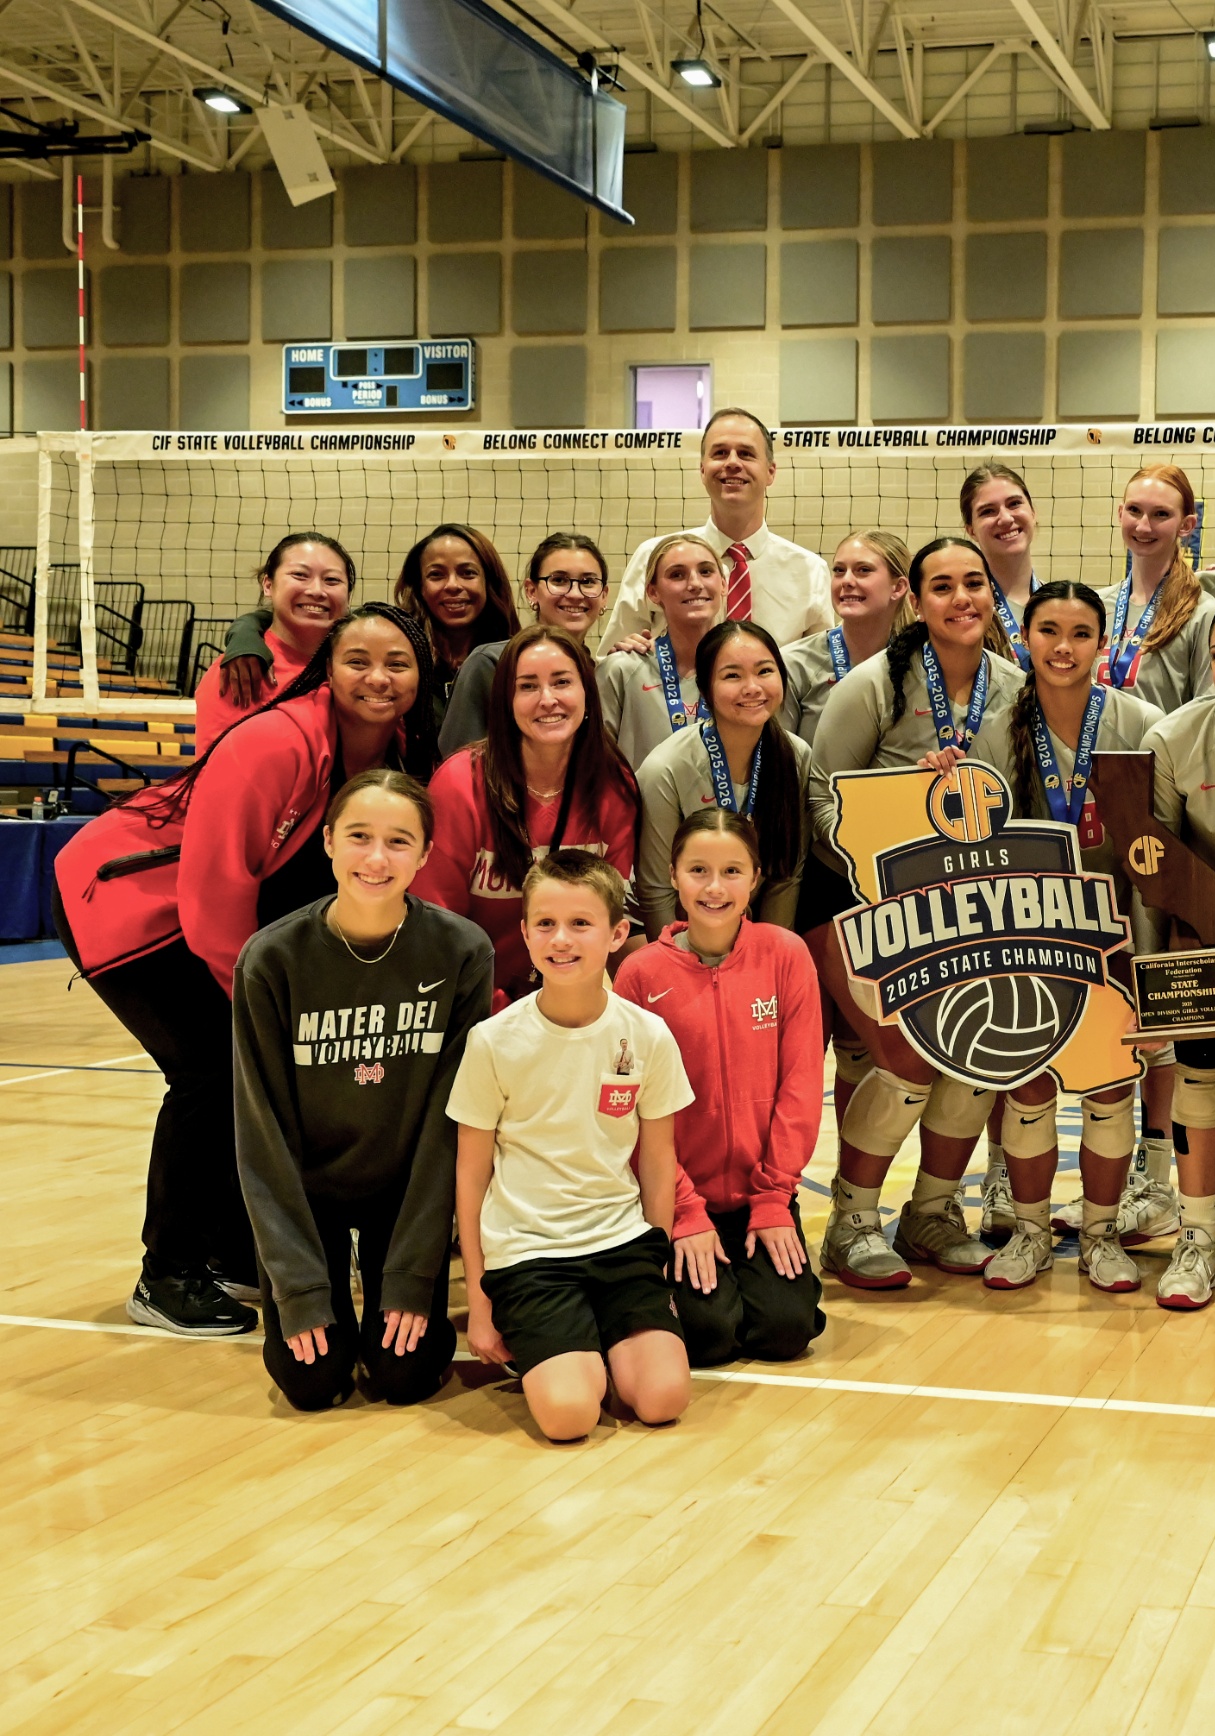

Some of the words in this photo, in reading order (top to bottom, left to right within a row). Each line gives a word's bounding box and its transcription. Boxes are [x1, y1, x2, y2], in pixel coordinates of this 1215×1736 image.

[291, 349, 324, 362] HOME
[423, 345, 468, 359] VISITOR
[304, 398, 331, 407] BONUS
[352, 390, 382, 400] PERIOD
[420, 395, 448, 404] BONUS
[152, 436, 171, 450] CIF
[177, 435, 217, 450] STATE
[224, 435, 304, 450] VOLLEYBALL
[311, 434, 416, 450] CHAMPIONSHIP
[483, 432, 537, 450] BELONG
[543, 431, 608, 449] CONNECT
[614, 431, 682, 448] COMPETE
[783, 431, 830, 447] STATE
[837, 429, 929, 447] VOLLEYBALL
[936, 429, 1057, 446] CHAMPIONSHIP
[1133, 427, 1196, 444] BELONG
[658, 643, 679, 706] 2025-2026
[923, 651, 947, 718] 2025-2026
[970, 658, 987, 722] CHAMPIONSHIPS
[1078, 694, 1102, 766] CHAMPIONSHIPS
[705, 736, 732, 807] 2025-2026
[944, 849, 1009, 873] GIRLS
[1128, 835, 1165, 876] CIF
[842, 877, 1125, 971] VOLLEYBALL
[1140, 960, 1175, 970] California
[1165, 966, 1202, 976] Federation
[886, 967, 931, 1004] 2025
[940, 950, 993, 979] STATE
[1002, 948, 1097, 975] CHAMPION
[1171, 980, 1199, 990] STATE
[298, 1004, 385, 1042] MATER
[396, 1000, 438, 1032] DEI
